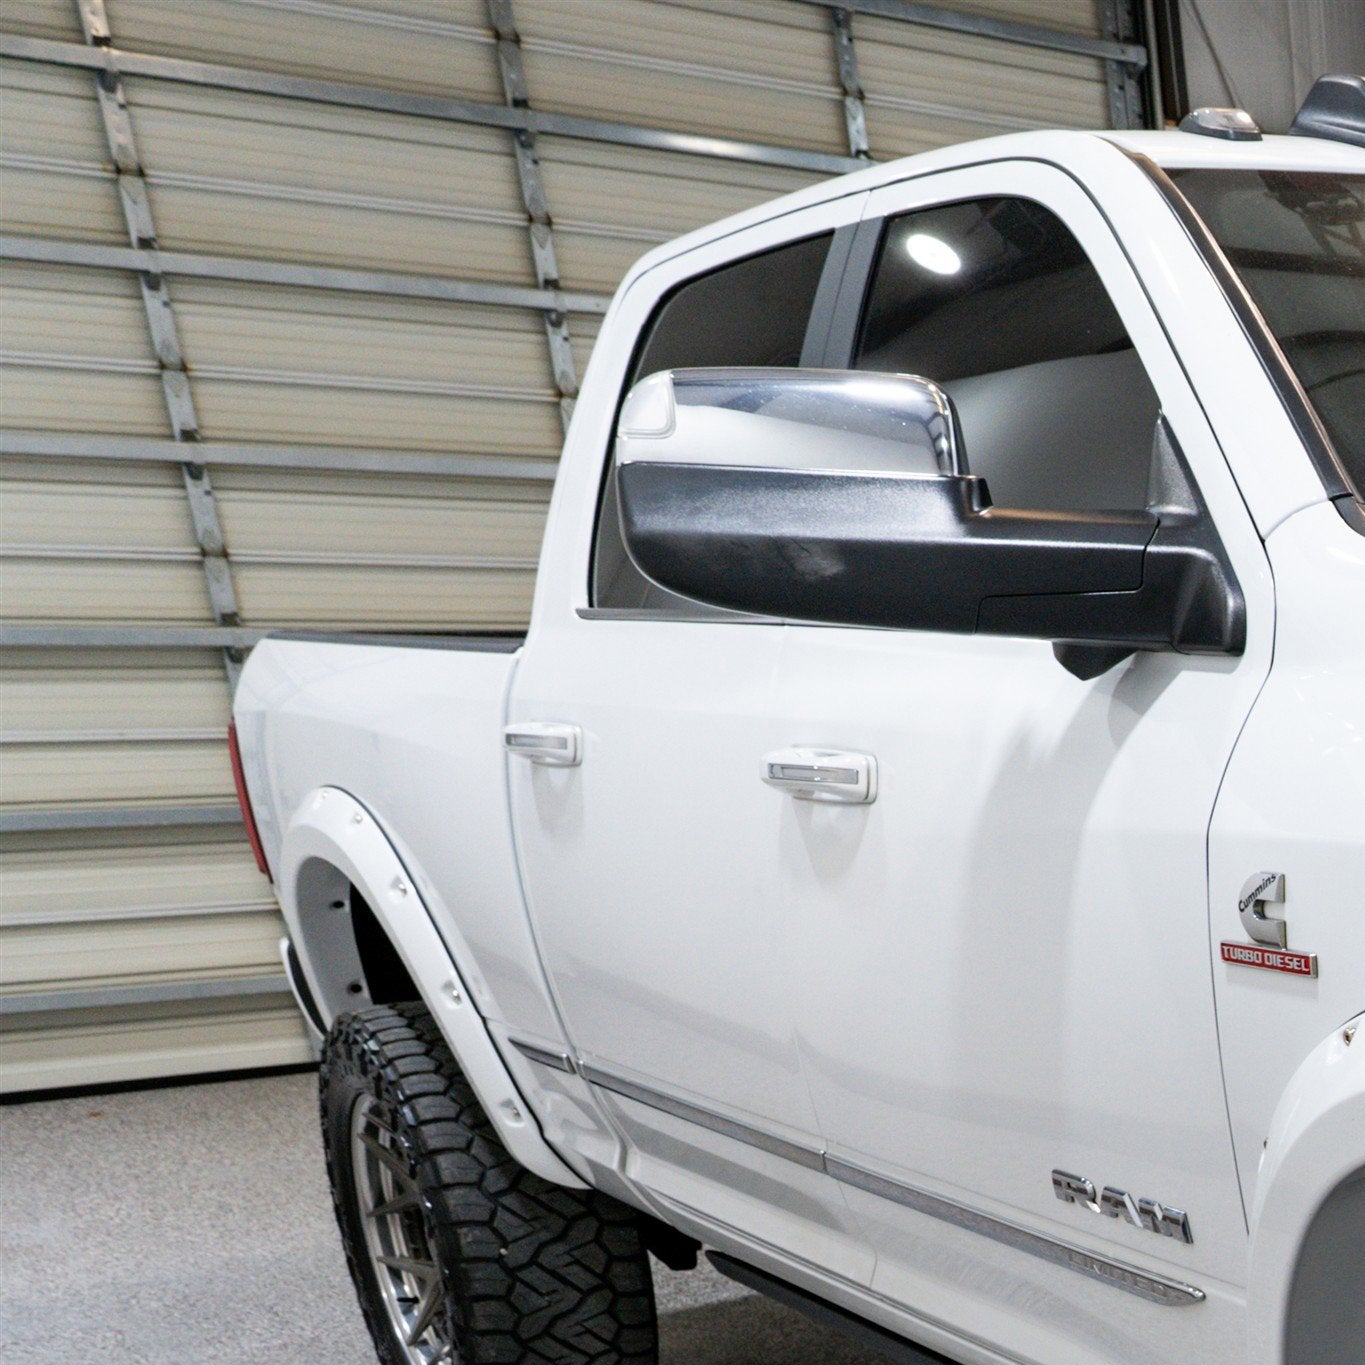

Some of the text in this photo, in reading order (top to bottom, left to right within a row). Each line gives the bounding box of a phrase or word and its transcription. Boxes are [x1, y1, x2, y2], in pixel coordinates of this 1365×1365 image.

[1238, 873, 1278, 913] Cummins
[1222, 945, 1310, 972] TURBO DIESEL
[1051, 1168, 1194, 1245] RAM
